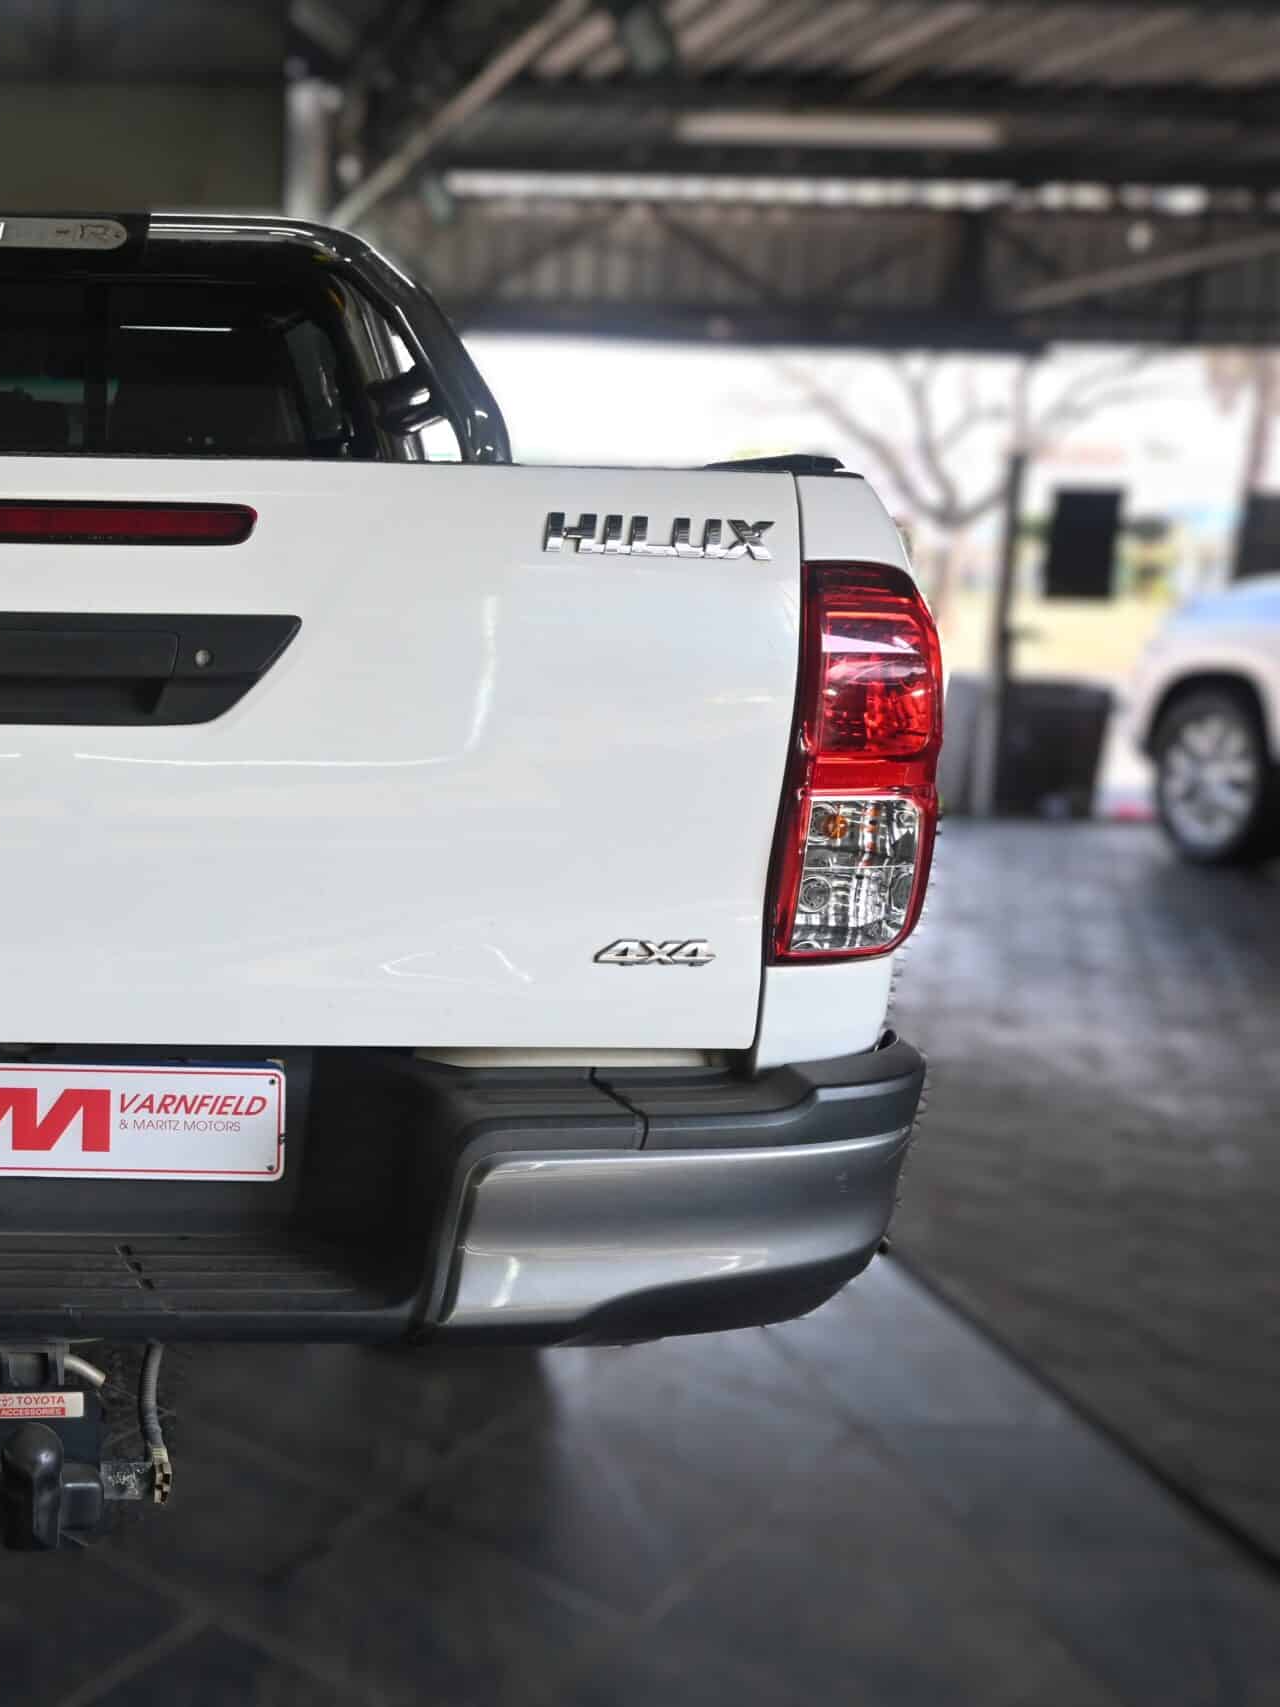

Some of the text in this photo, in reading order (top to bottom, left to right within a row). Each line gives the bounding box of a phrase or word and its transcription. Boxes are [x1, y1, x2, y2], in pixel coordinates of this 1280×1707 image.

[543, 511, 775, 560] HILUX
[119, 1093, 268, 1116] VARNFIELD
[119, 1119, 241, 1132] & MARITZ MOTORS
[16, 1396, 65, 1406] TOYOTA
